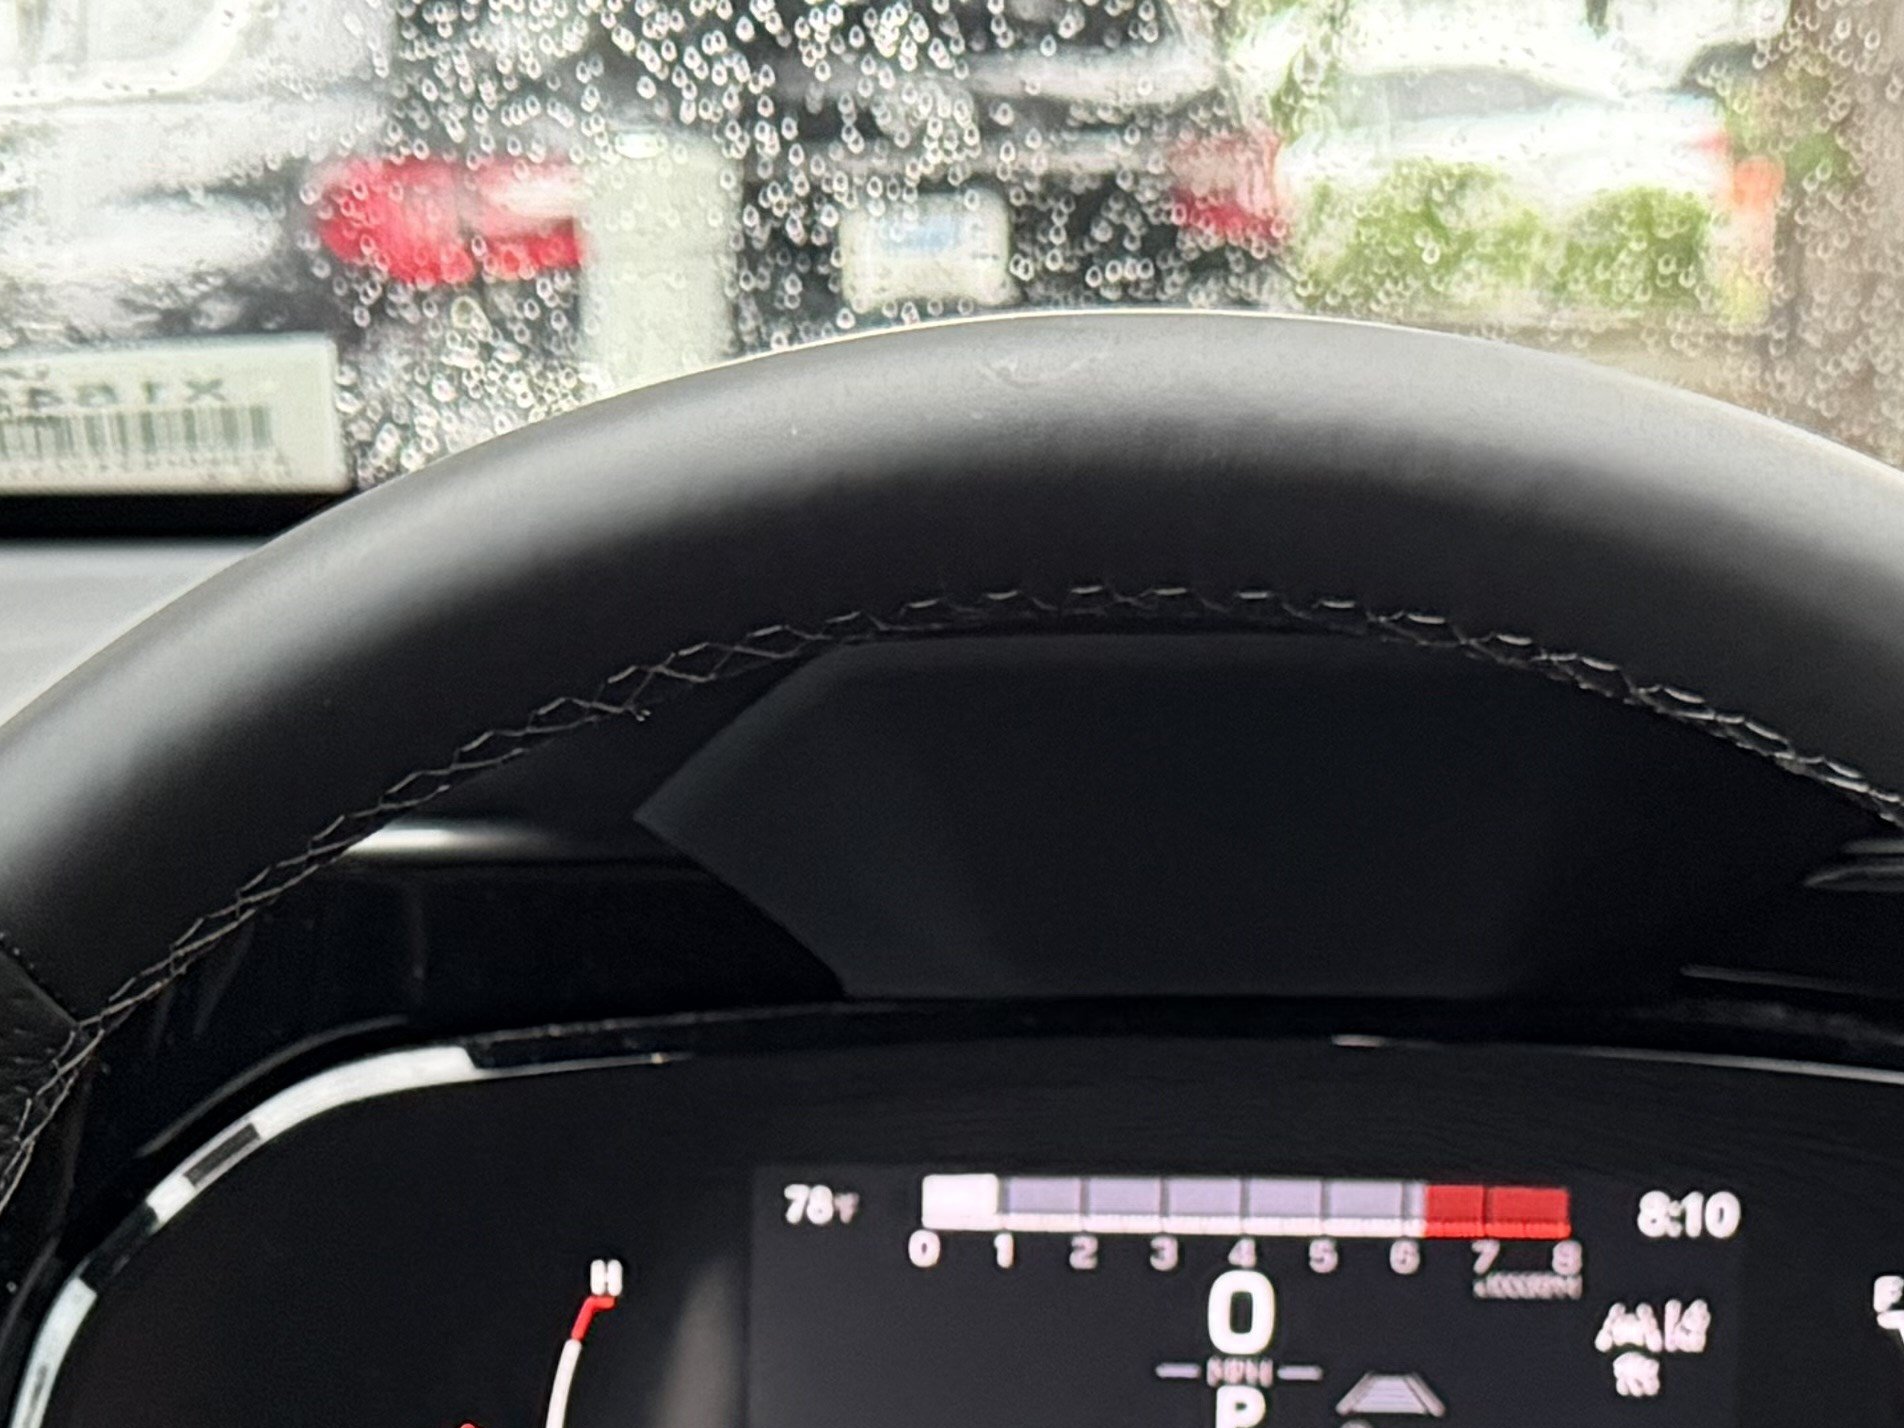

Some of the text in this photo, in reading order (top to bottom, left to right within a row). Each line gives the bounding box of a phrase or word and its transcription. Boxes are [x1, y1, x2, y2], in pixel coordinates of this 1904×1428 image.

[1637, 1190, 1741, 1239] 8:10
[908, 1229, 1583, 1276] 0 1 2 3 4 5 6 7 8
[590, 1259, 623, 1296] H
[1207, 1269, 1275, 1355] 0
